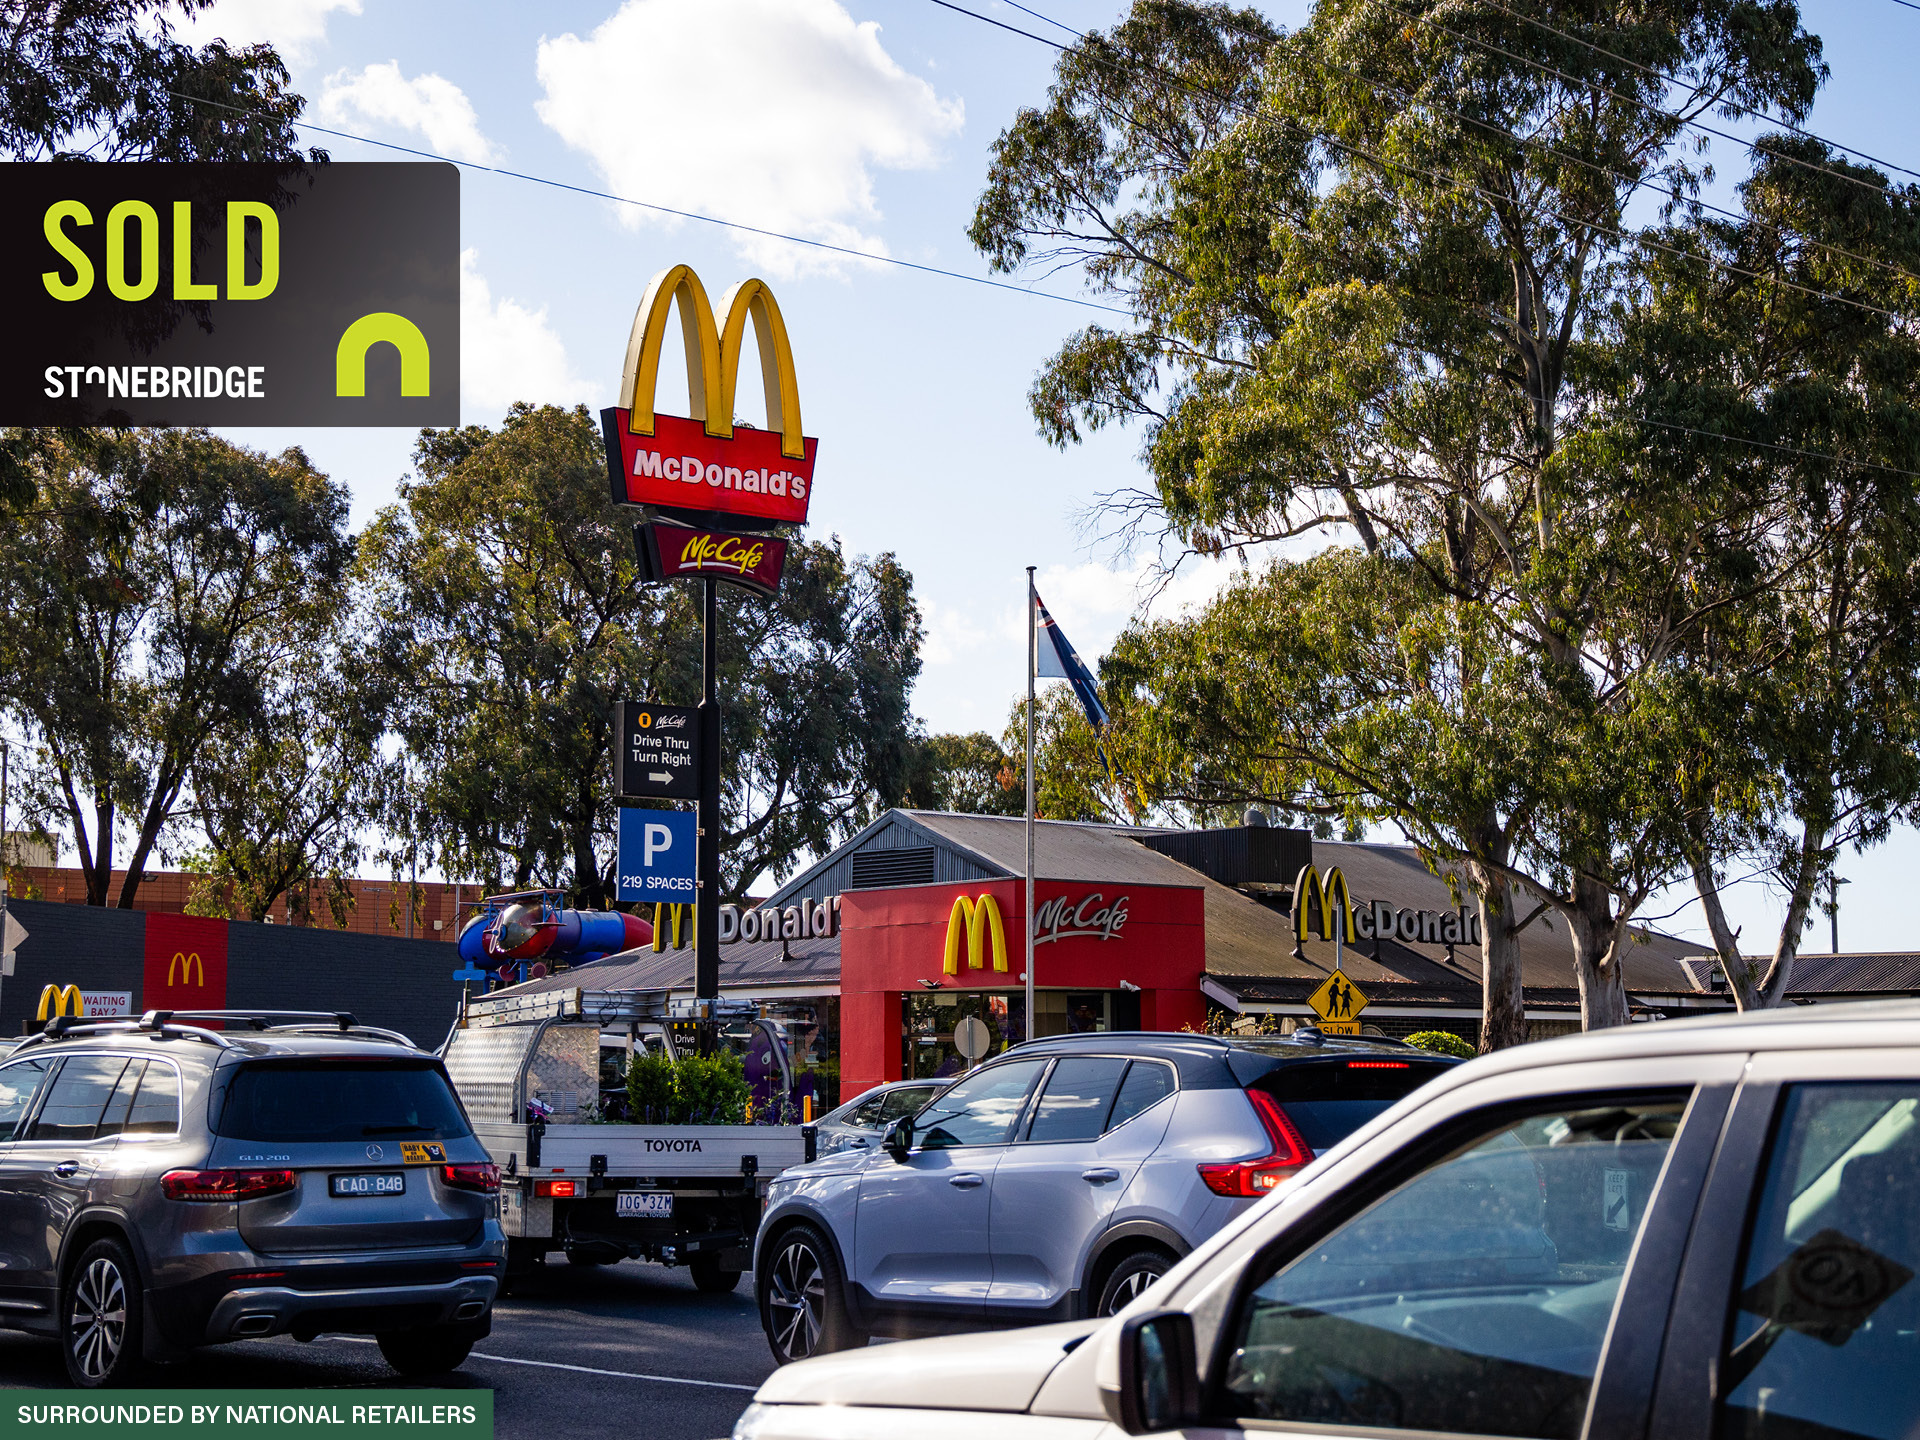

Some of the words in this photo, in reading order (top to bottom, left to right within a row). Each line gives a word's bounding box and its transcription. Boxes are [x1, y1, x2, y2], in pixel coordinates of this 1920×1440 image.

[632, 448, 807, 500] McDonald's
[680, 534, 764, 574] McCafé
[633, 733, 663, 748] Drive
[664, 735, 690, 750] Thru
[632, 749, 659, 764] Turn
[661, 751, 692, 767] Right
[643, 823, 673, 867] P
[622, 875, 643, 889] 219
[646, 877, 693, 891] SPACES
[1033, 892, 1130, 944] McCafé
[83, 995, 126, 1006] WAITING
[90, 1007, 109, 1017] BAY
[111, 1007, 117, 1017] 2
[1322, 1026, 1354, 1036] SLOW
[675, 1034, 696, 1044] Drive
[676, 1046, 695, 1056] Thru
[644, 1139, 702, 1153] TOYOTA
[649, 1195, 672, 1210] 3ZM
